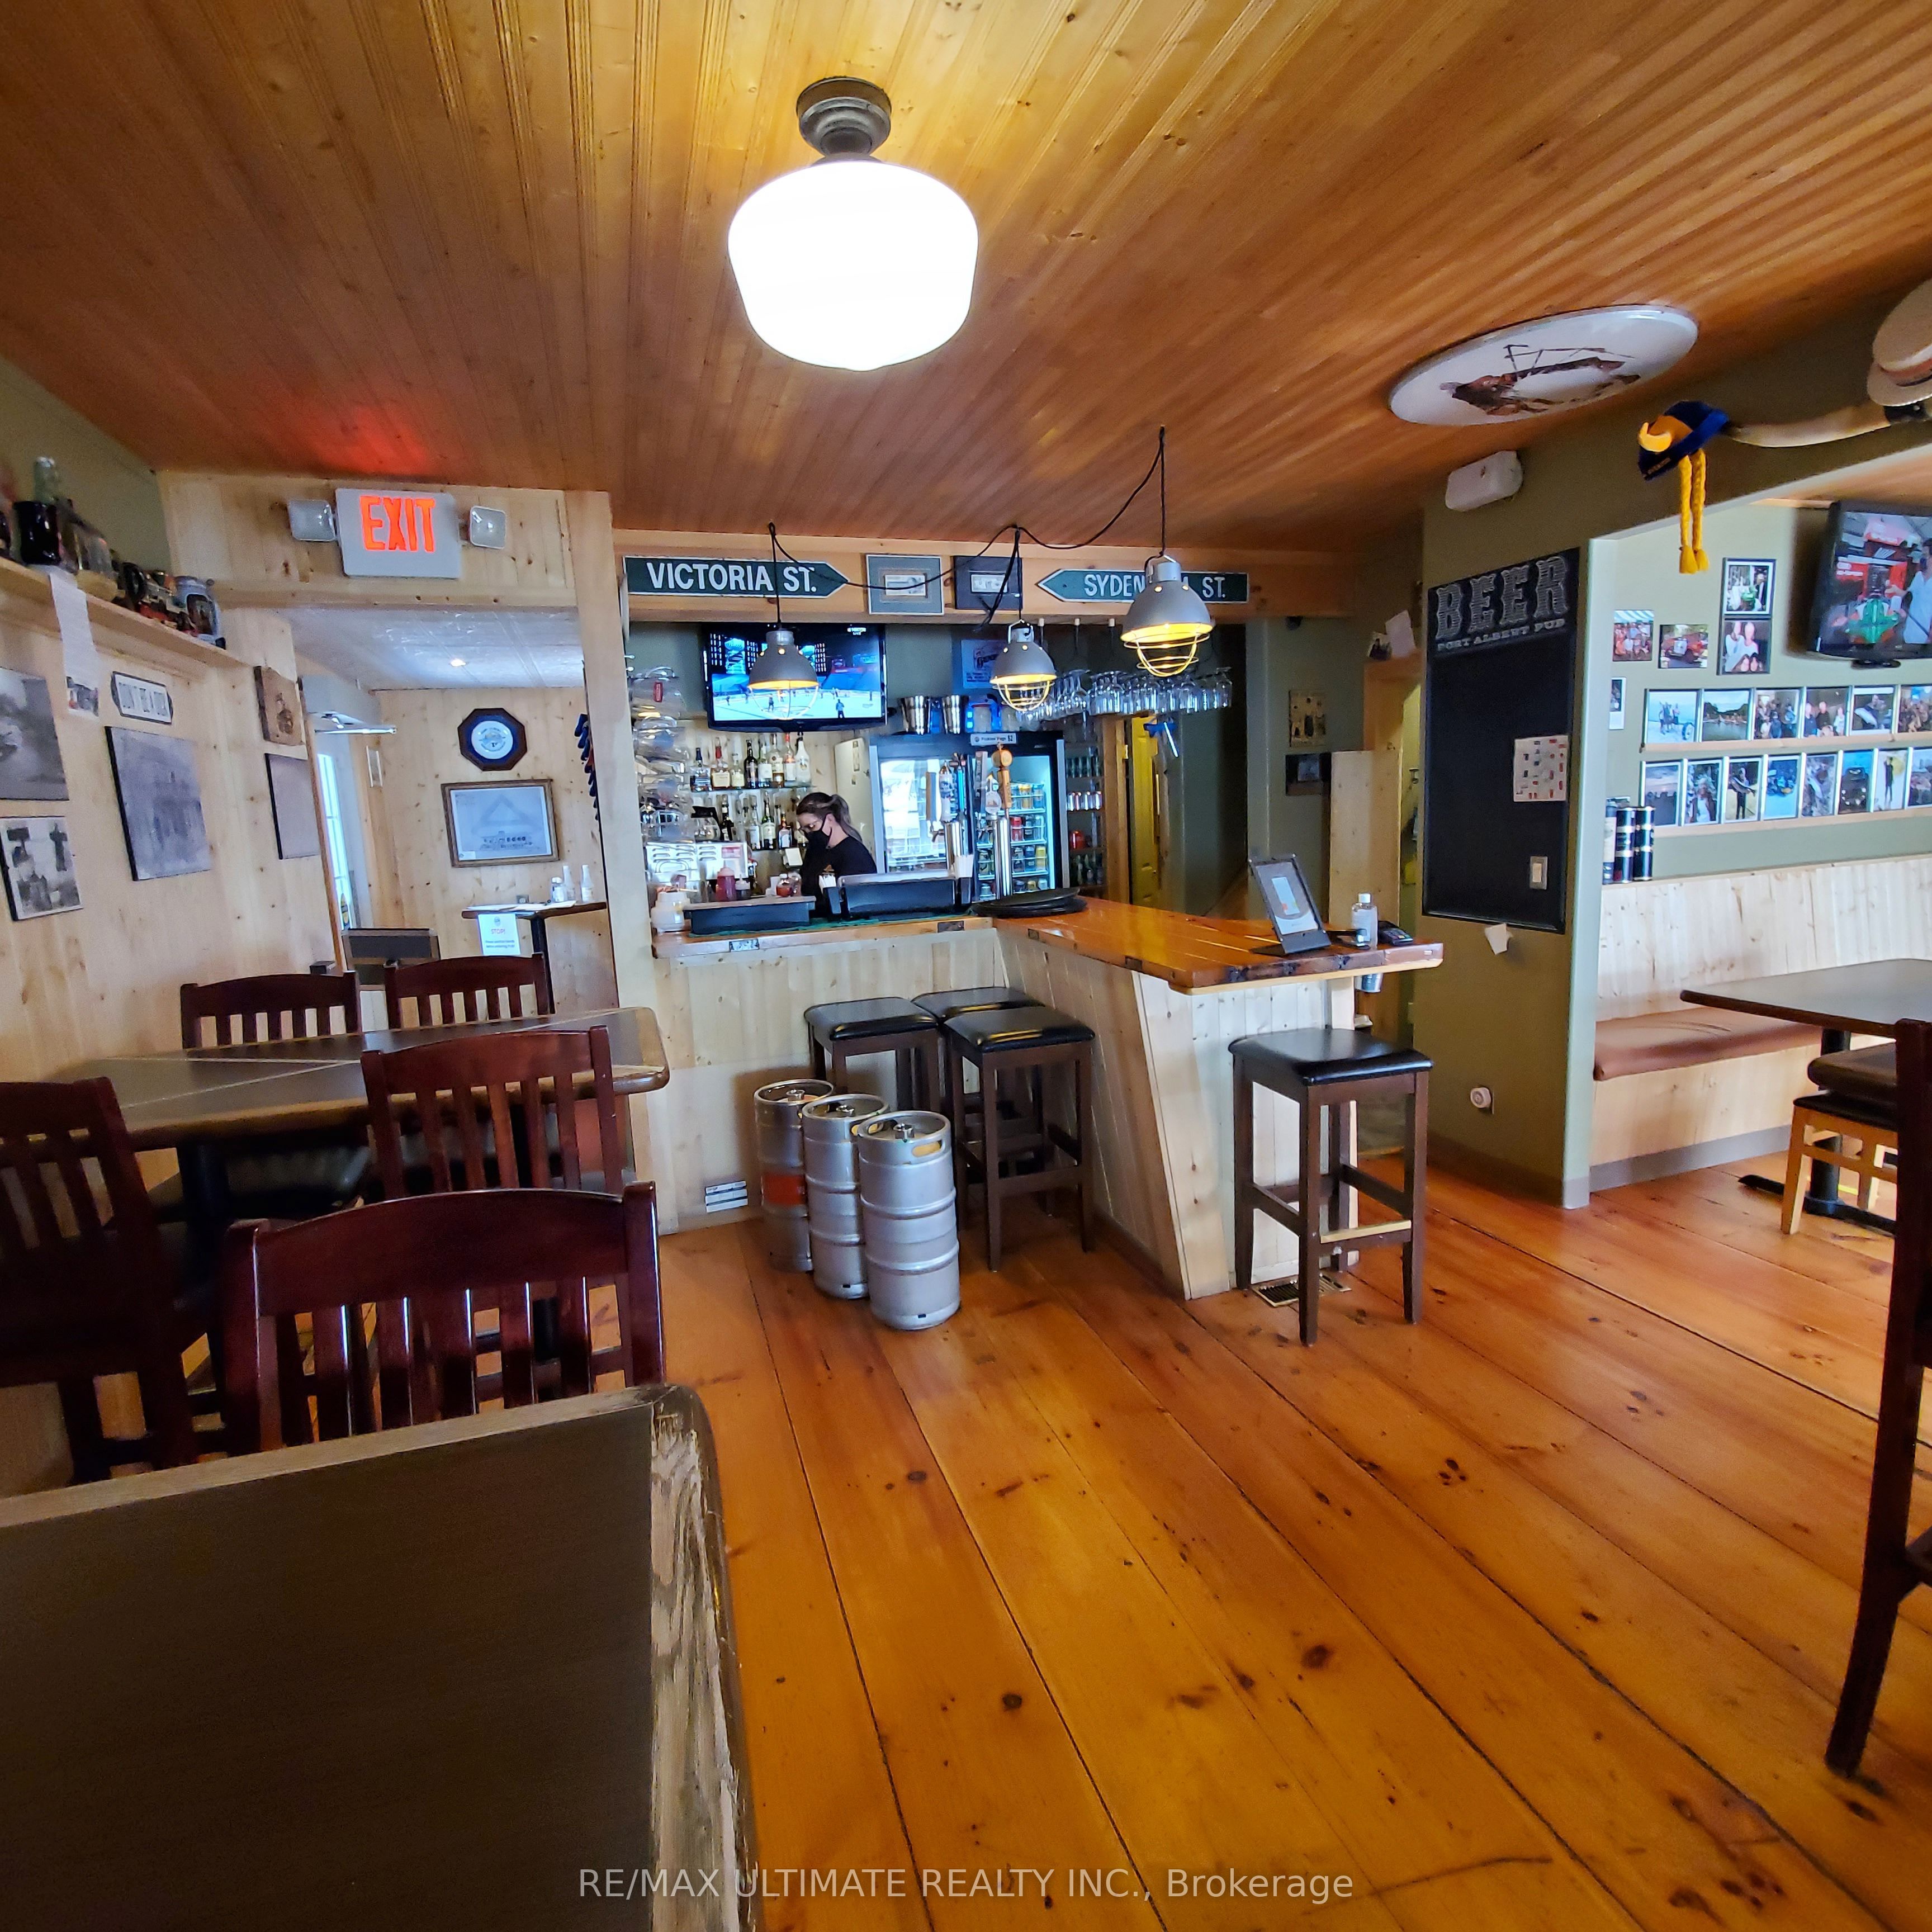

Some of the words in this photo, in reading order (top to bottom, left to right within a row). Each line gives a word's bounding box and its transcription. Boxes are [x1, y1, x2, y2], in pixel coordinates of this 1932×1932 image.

[360, 495, 435, 553] EXIT
[646, 562, 774, 591] VICTORIA
[783, 566, 817, 593] ST.
[1083, 574, 1189, 598] SYDEN
[1202, 576, 1226, 598] ST.
[1435, 556, 1569, 641] BEER
